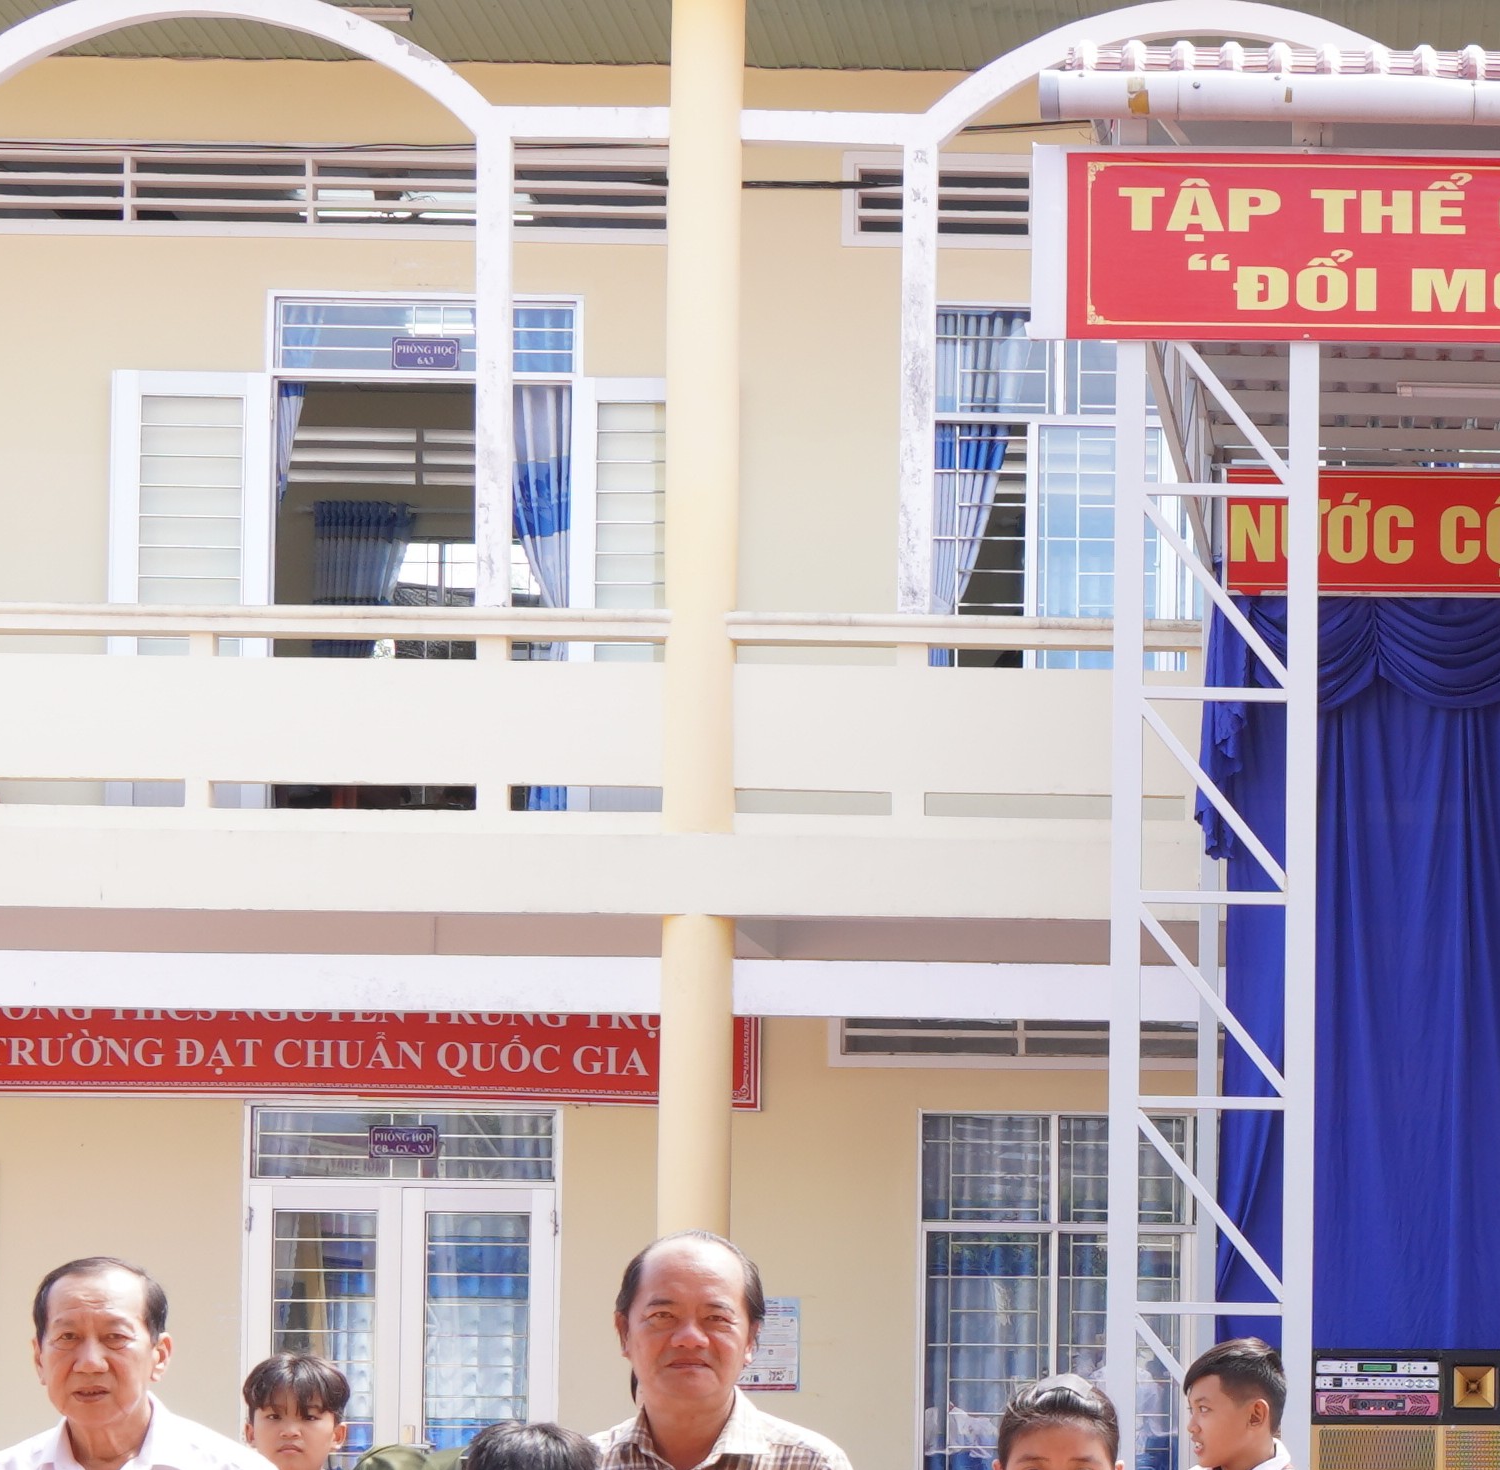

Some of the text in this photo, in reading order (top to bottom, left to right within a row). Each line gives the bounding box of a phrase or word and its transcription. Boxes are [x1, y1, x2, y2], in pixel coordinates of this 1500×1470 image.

[1119, 179, 1281, 240] TẬP
[1311, 175, 1472, 234] THỂ
[397, 343, 455, 356] PHÒNG HỌC
[1230, 493, 1414, 564] NỚC
[176, 1038, 262, 1076] ĐẠT
[274, 1031, 424, 1070] CHUẨN
[437, 1035, 560, 1078] QUỐC
[573, 1045, 650, 1077] GIA
[374, 1131, 433, 1144] PHÒNG HỌP
[418, 1145, 432, 1153] NV
